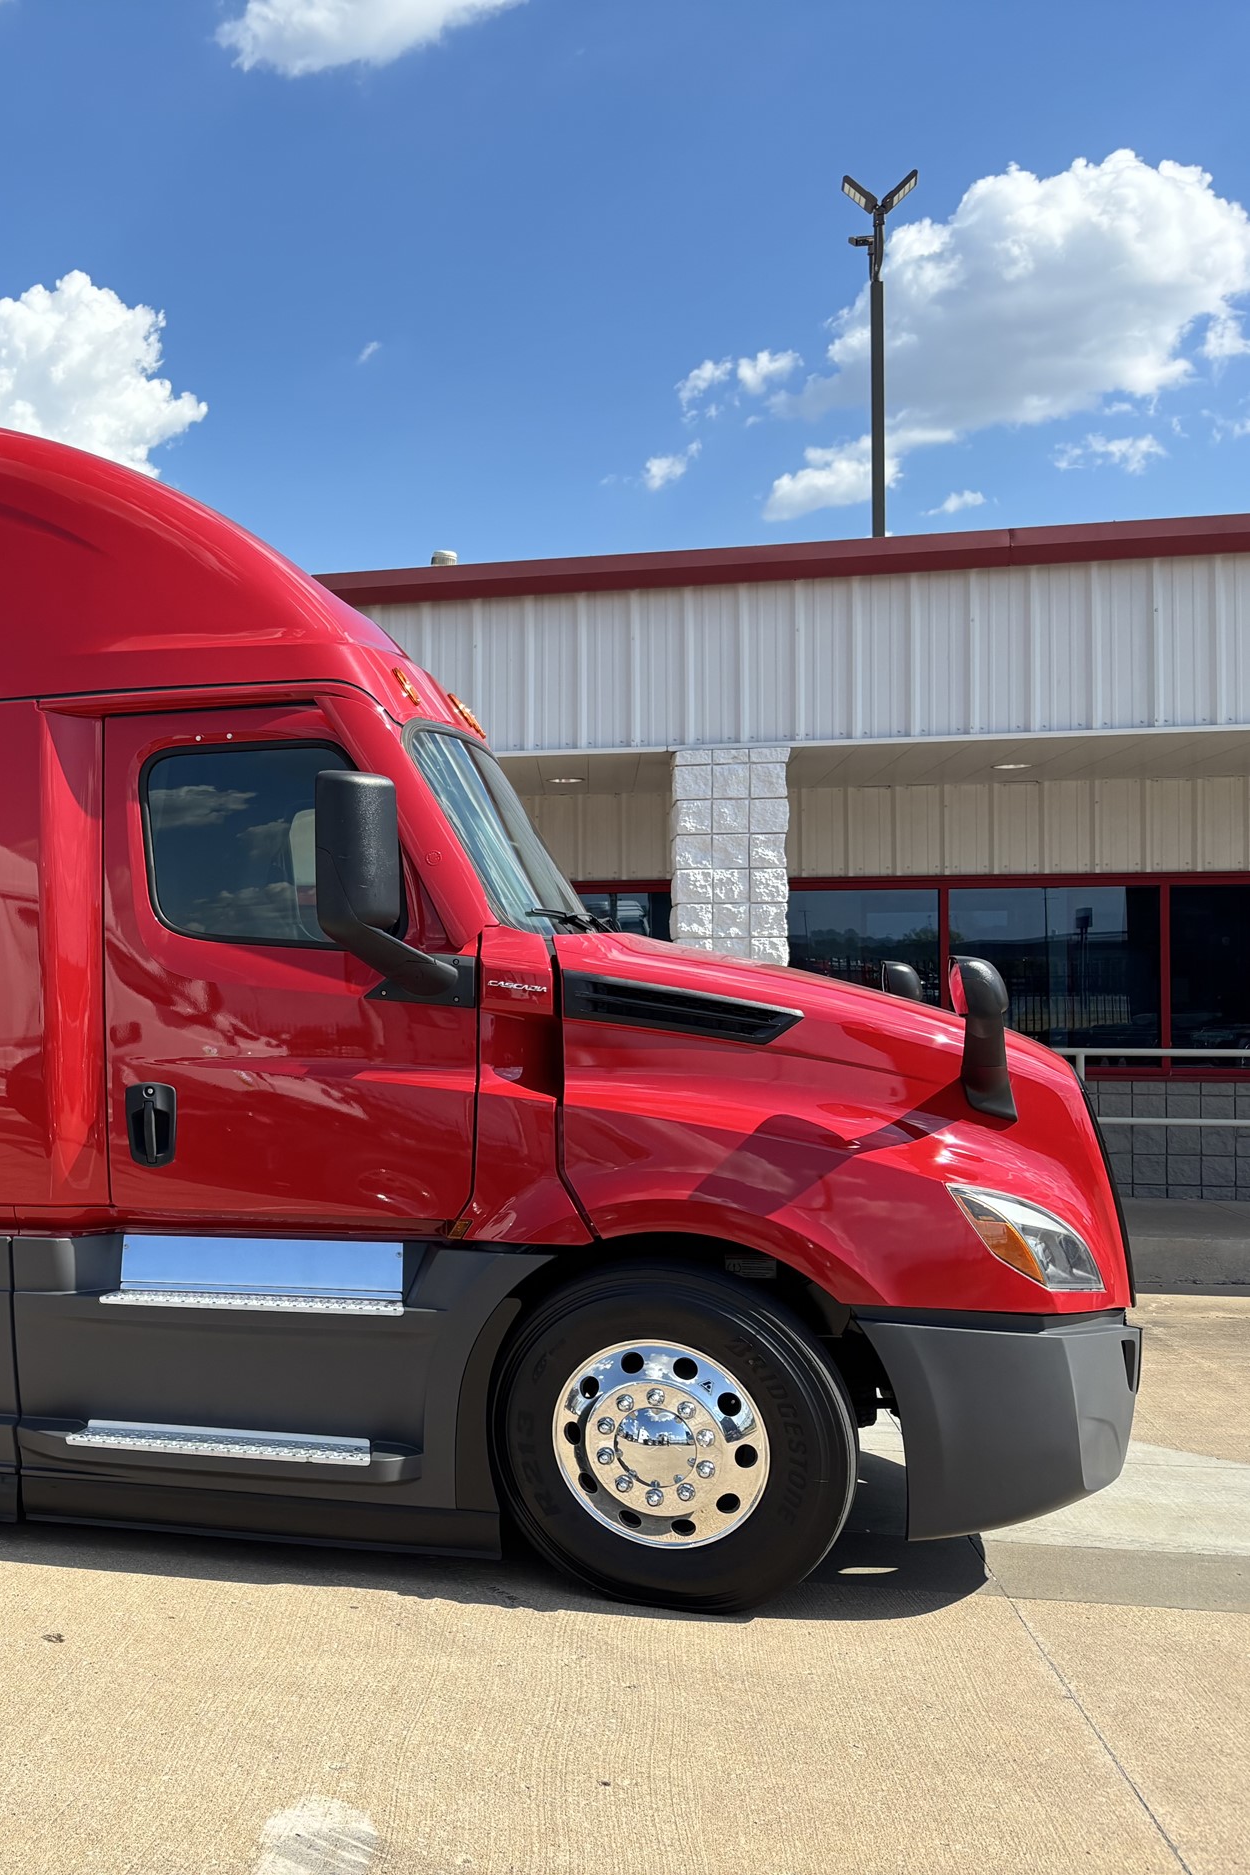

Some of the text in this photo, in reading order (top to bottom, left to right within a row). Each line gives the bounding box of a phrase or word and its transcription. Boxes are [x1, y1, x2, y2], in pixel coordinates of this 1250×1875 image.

[487, 980, 547, 993] CASCADIA
[518, 1411, 558, 1517] R213
[725, 1336, 808, 1525] BRIDGESTONE
